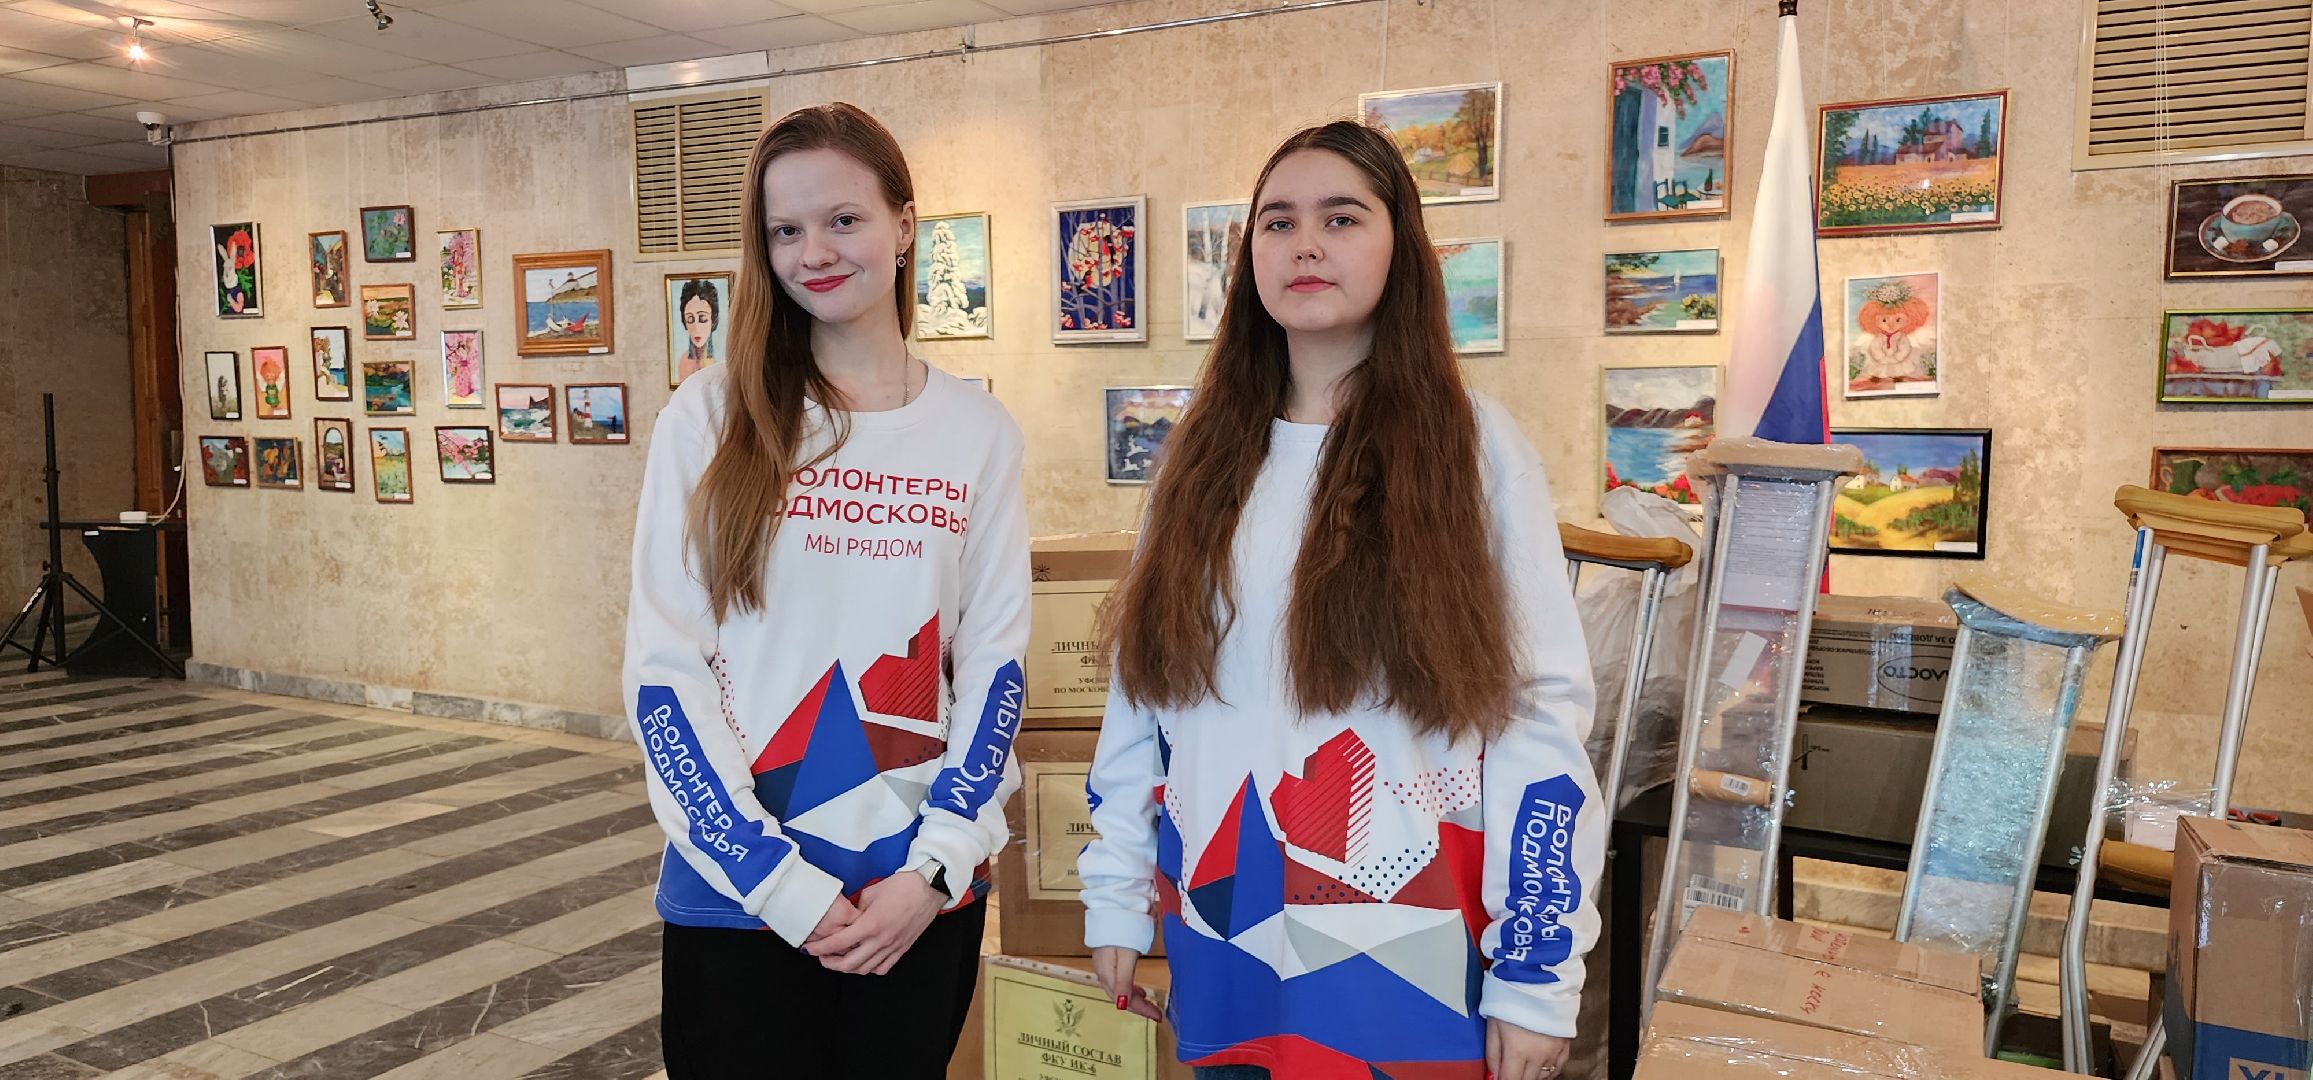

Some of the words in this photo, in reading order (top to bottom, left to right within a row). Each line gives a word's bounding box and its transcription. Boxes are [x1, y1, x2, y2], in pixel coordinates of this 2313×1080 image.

[787, 466, 968, 503] ОЛОНТЕРЫ
[770, 494, 968, 537] ОДМОСКОВЬЯ
[804, 533, 841, 555] МЫ
[846, 537, 923, 560] РЯДОМ
[1051, 641, 1100, 651] ЛИЧНЫ
[993, 679, 1022, 739] МЫ
[653, 704, 733, 831] ВОЛОНТЕР
[1018, 1032, 1070, 1052] ЛИЧНЫЙ
[1073, 1045, 1122, 1064] СОСТАВ
[1041, 1052, 1065, 1066] ФКУ
